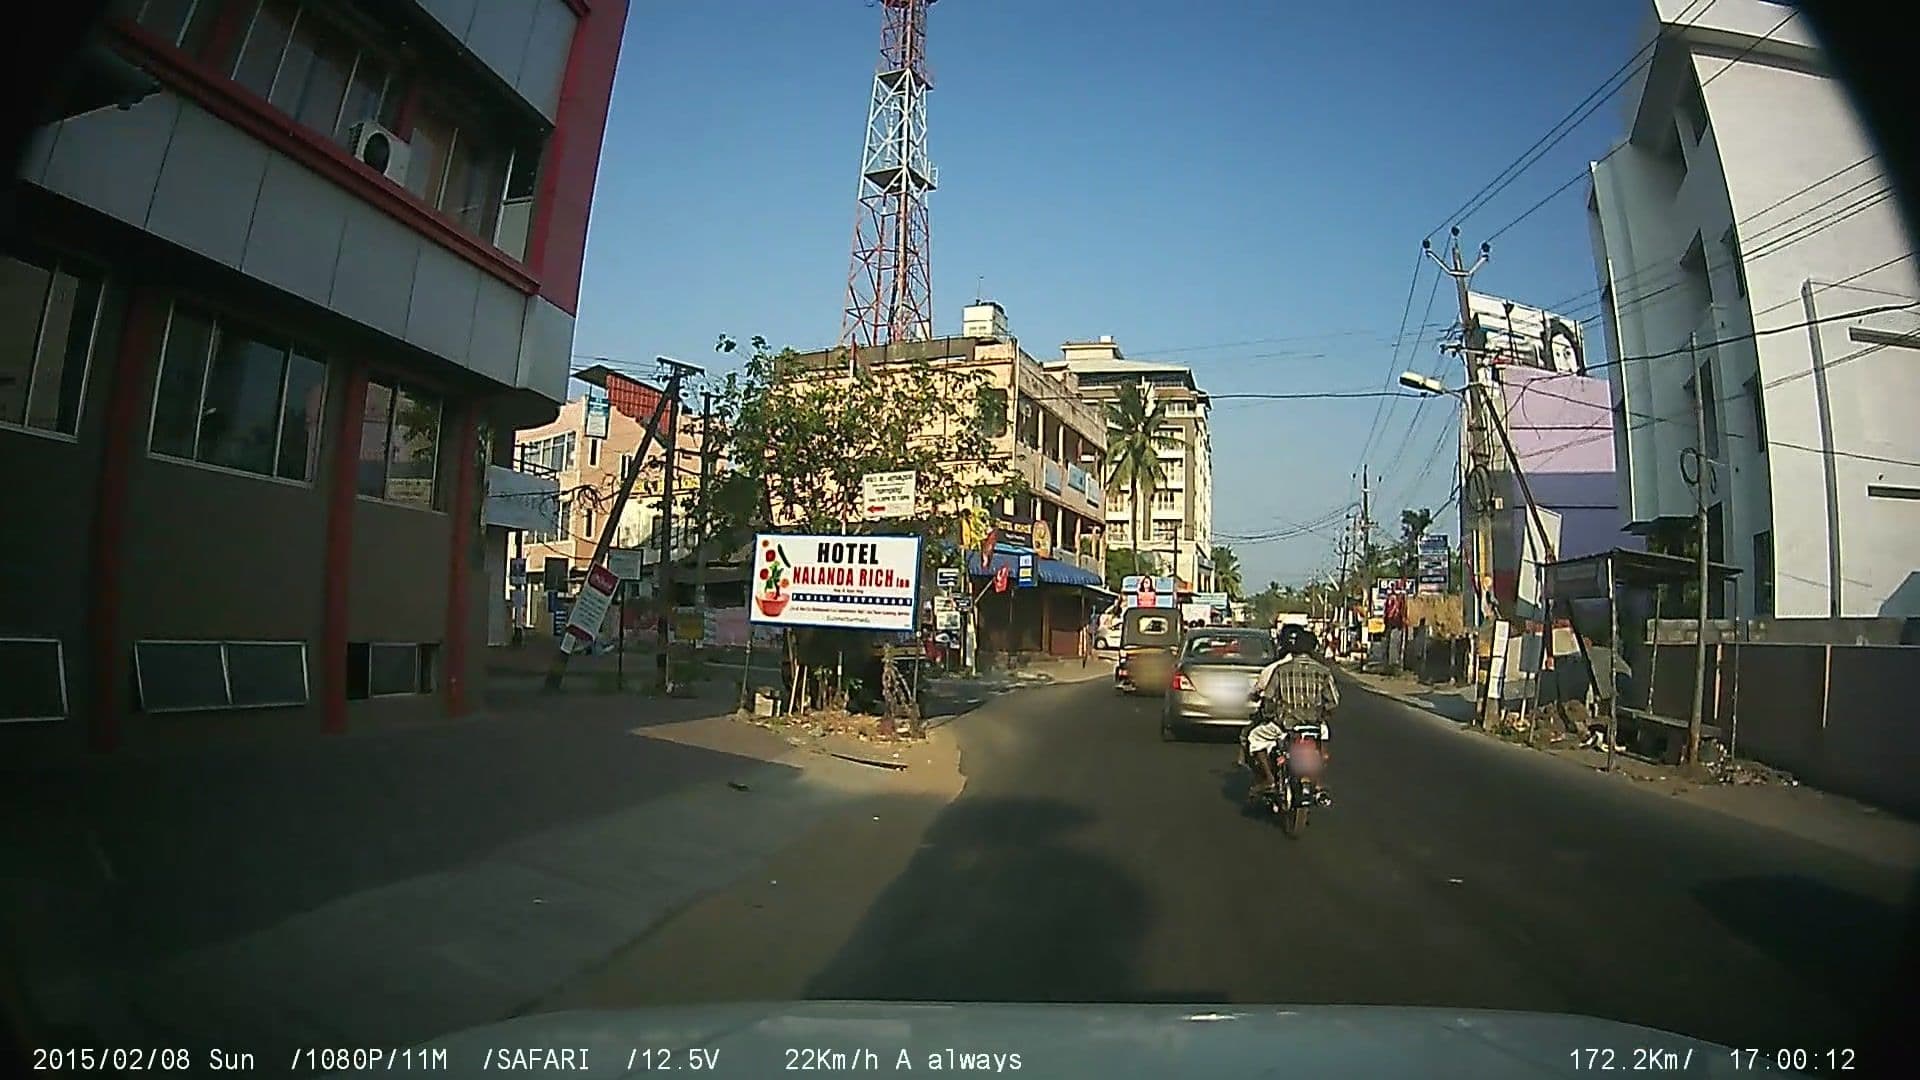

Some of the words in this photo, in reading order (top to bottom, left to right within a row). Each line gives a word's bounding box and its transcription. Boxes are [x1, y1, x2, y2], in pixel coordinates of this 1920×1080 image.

[817, 542, 879, 565] HOTEL
[793, 566, 854, 587] NALANDA
[859, 568, 894, 588] RICH
